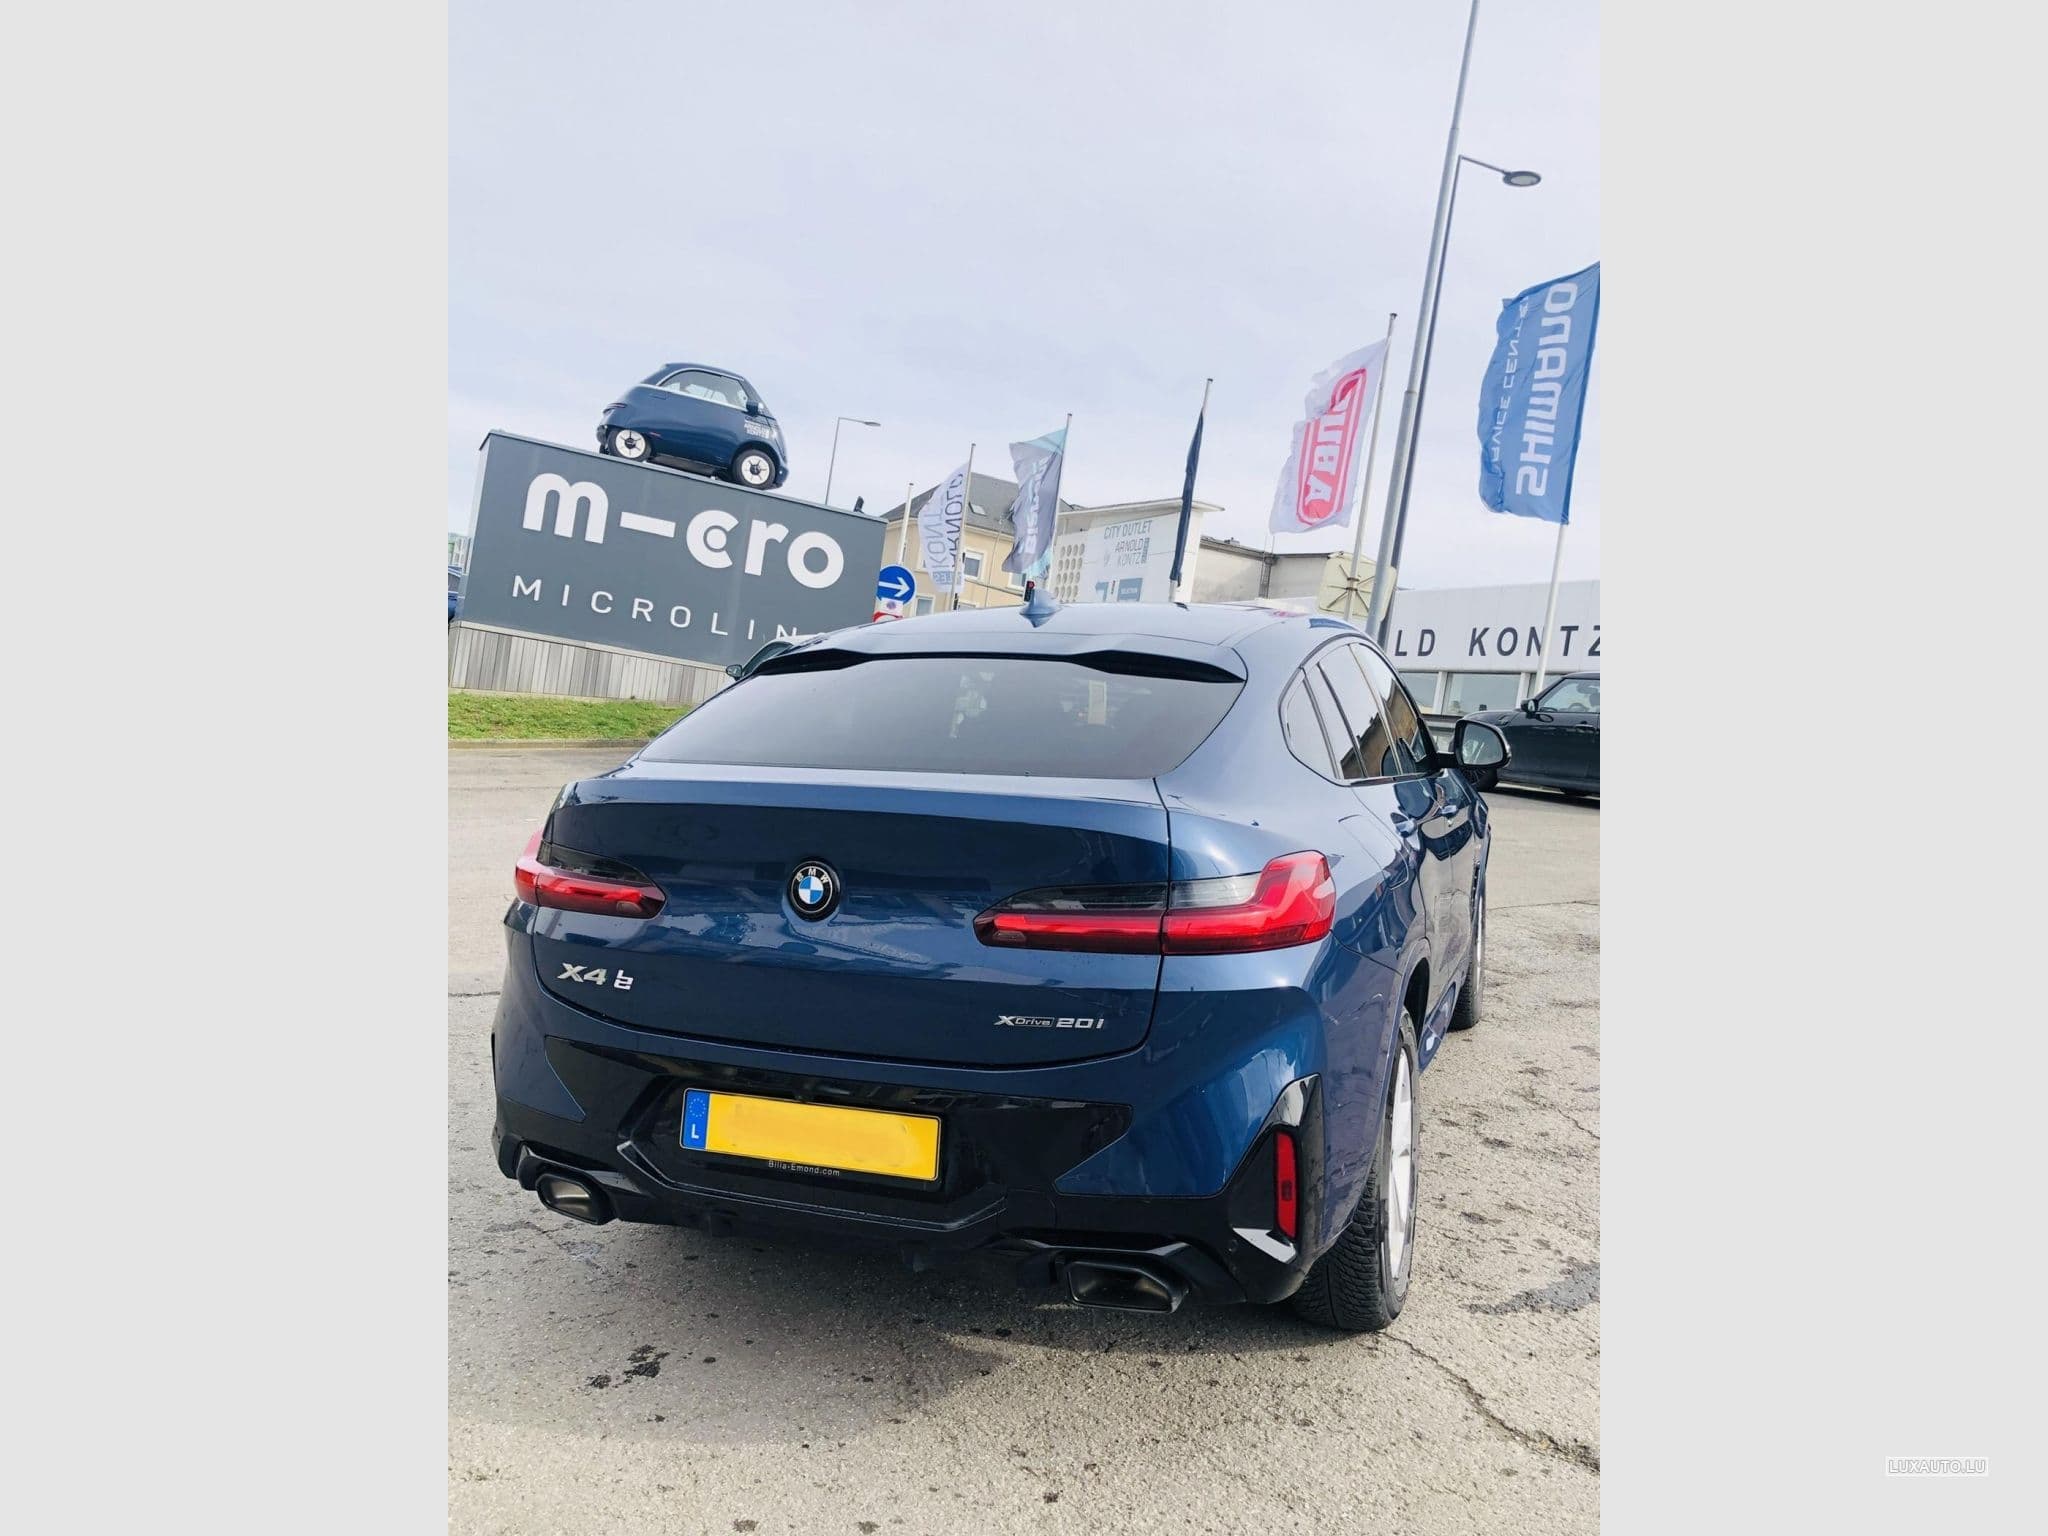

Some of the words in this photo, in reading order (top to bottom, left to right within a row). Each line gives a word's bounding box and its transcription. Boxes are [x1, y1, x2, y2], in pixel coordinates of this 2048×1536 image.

[1122, 519, 1152, 537] OUTLET
[796, 868, 829, 884] BMW
[557, 962, 607, 986] X4
[691, 1123, 700, 1139] L
